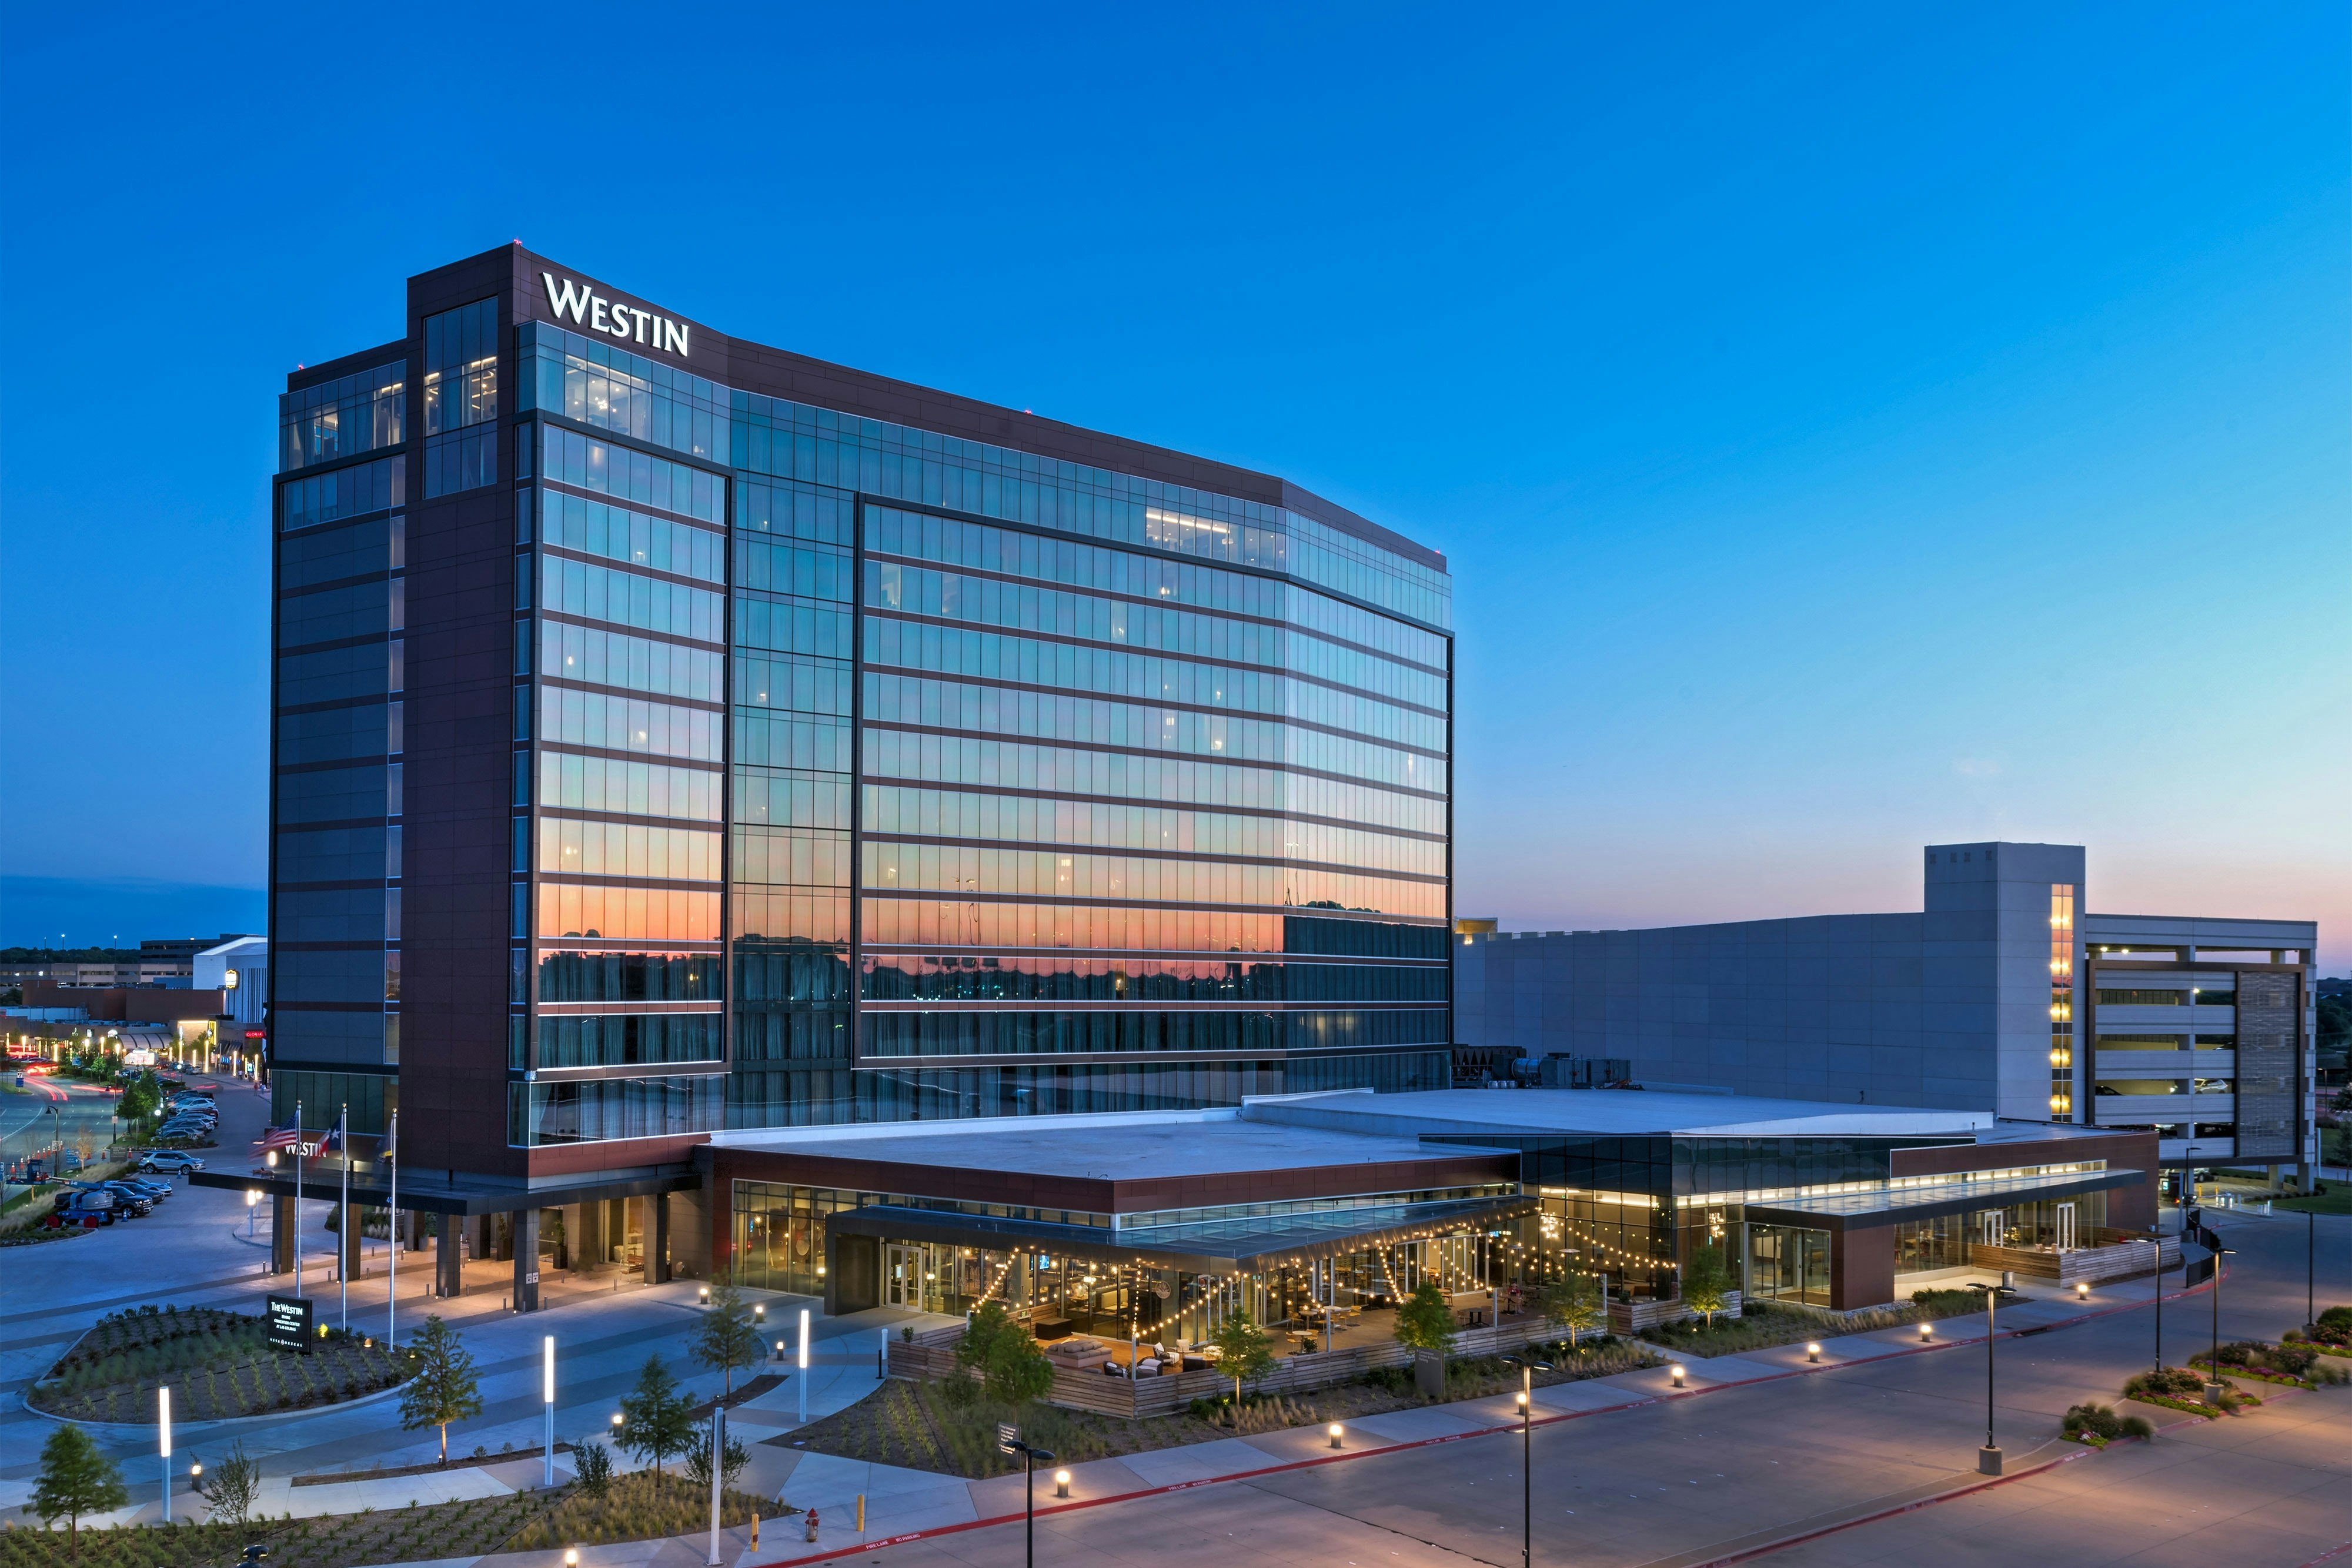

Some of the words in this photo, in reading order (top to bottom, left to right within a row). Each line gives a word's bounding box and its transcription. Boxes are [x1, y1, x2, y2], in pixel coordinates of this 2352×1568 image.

[542, 272, 689, 357] WESTIN
[271, 1301, 281, 1312] THE
[281, 1304, 303, 1315] WESTIN
